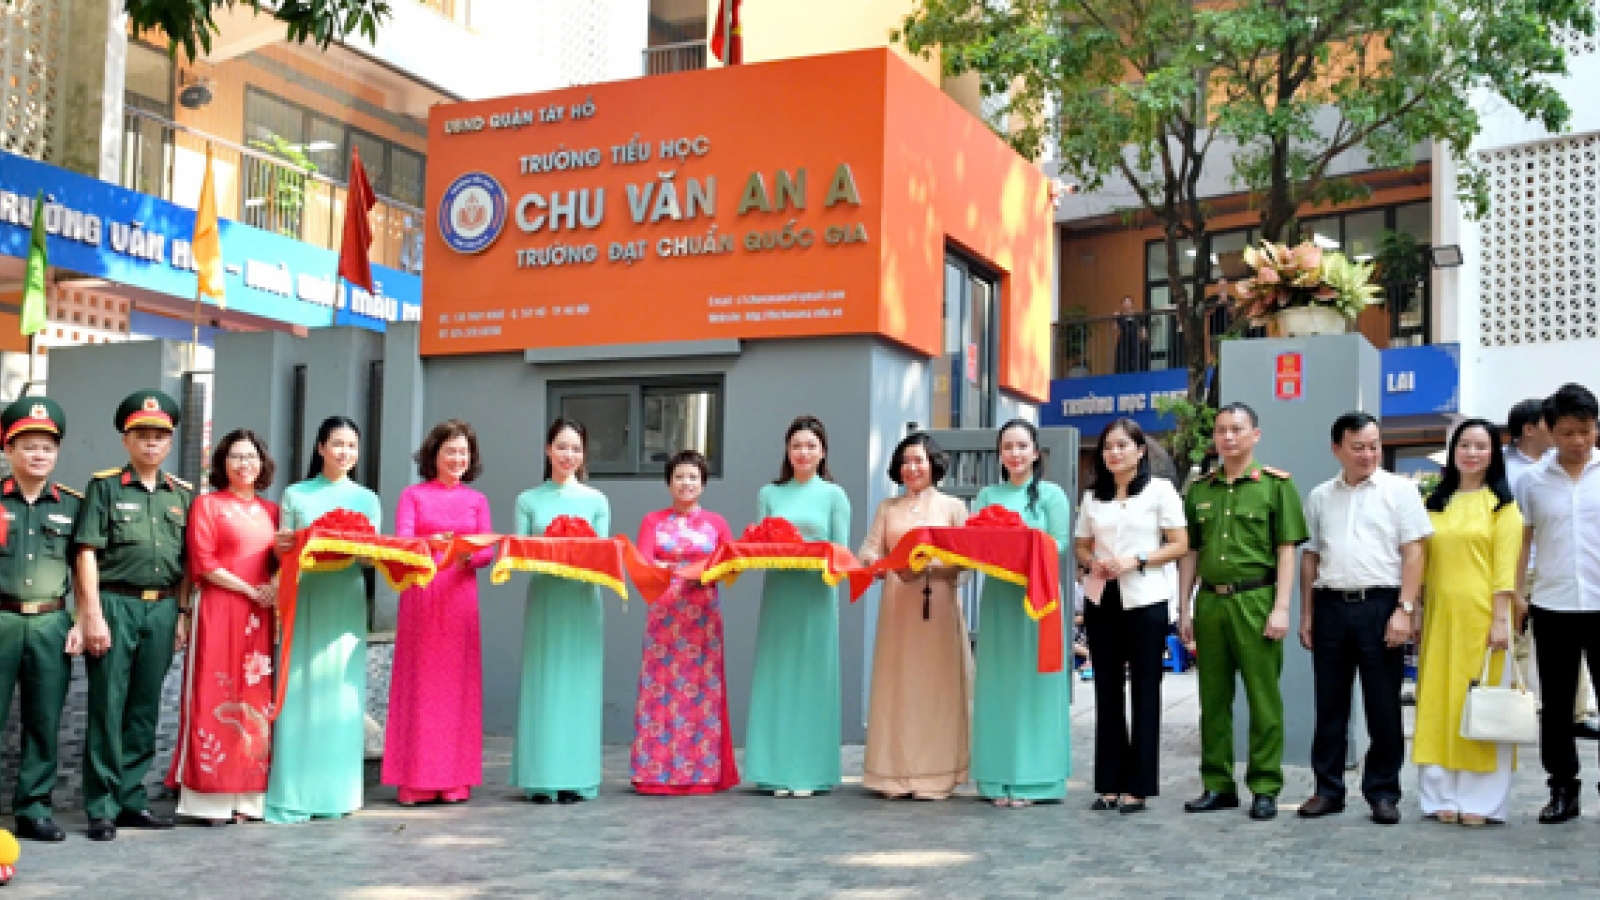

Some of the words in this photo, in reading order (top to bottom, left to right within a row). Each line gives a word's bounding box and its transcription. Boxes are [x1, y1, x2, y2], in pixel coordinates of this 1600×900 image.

[490, 107, 533, 130] QUẬN
[571, 94, 596, 118] HỒ
[519, 143, 601, 174] TRƯỜNG
[610, 132, 651, 164] TIỂU
[659, 135, 710, 165] HỌC
[515, 187, 605, 233] CHU
[625, 169, 717, 223] VĂN
[737, 167, 807, 215] AN
[823, 163, 862, 208] A
[0, 190, 101, 246] RƯỜNG
[109, 220, 164, 263] VĂN
[515, 239, 598, 268] TRƯỜNG
[608, 239, 648, 264] ĐẠT
[656, 221, 733, 257] CHUẨN
[743, 219, 815, 251] QUỐC
[824, 221, 869, 244] GIA
[1387, 370, 1416, 392] LAI
